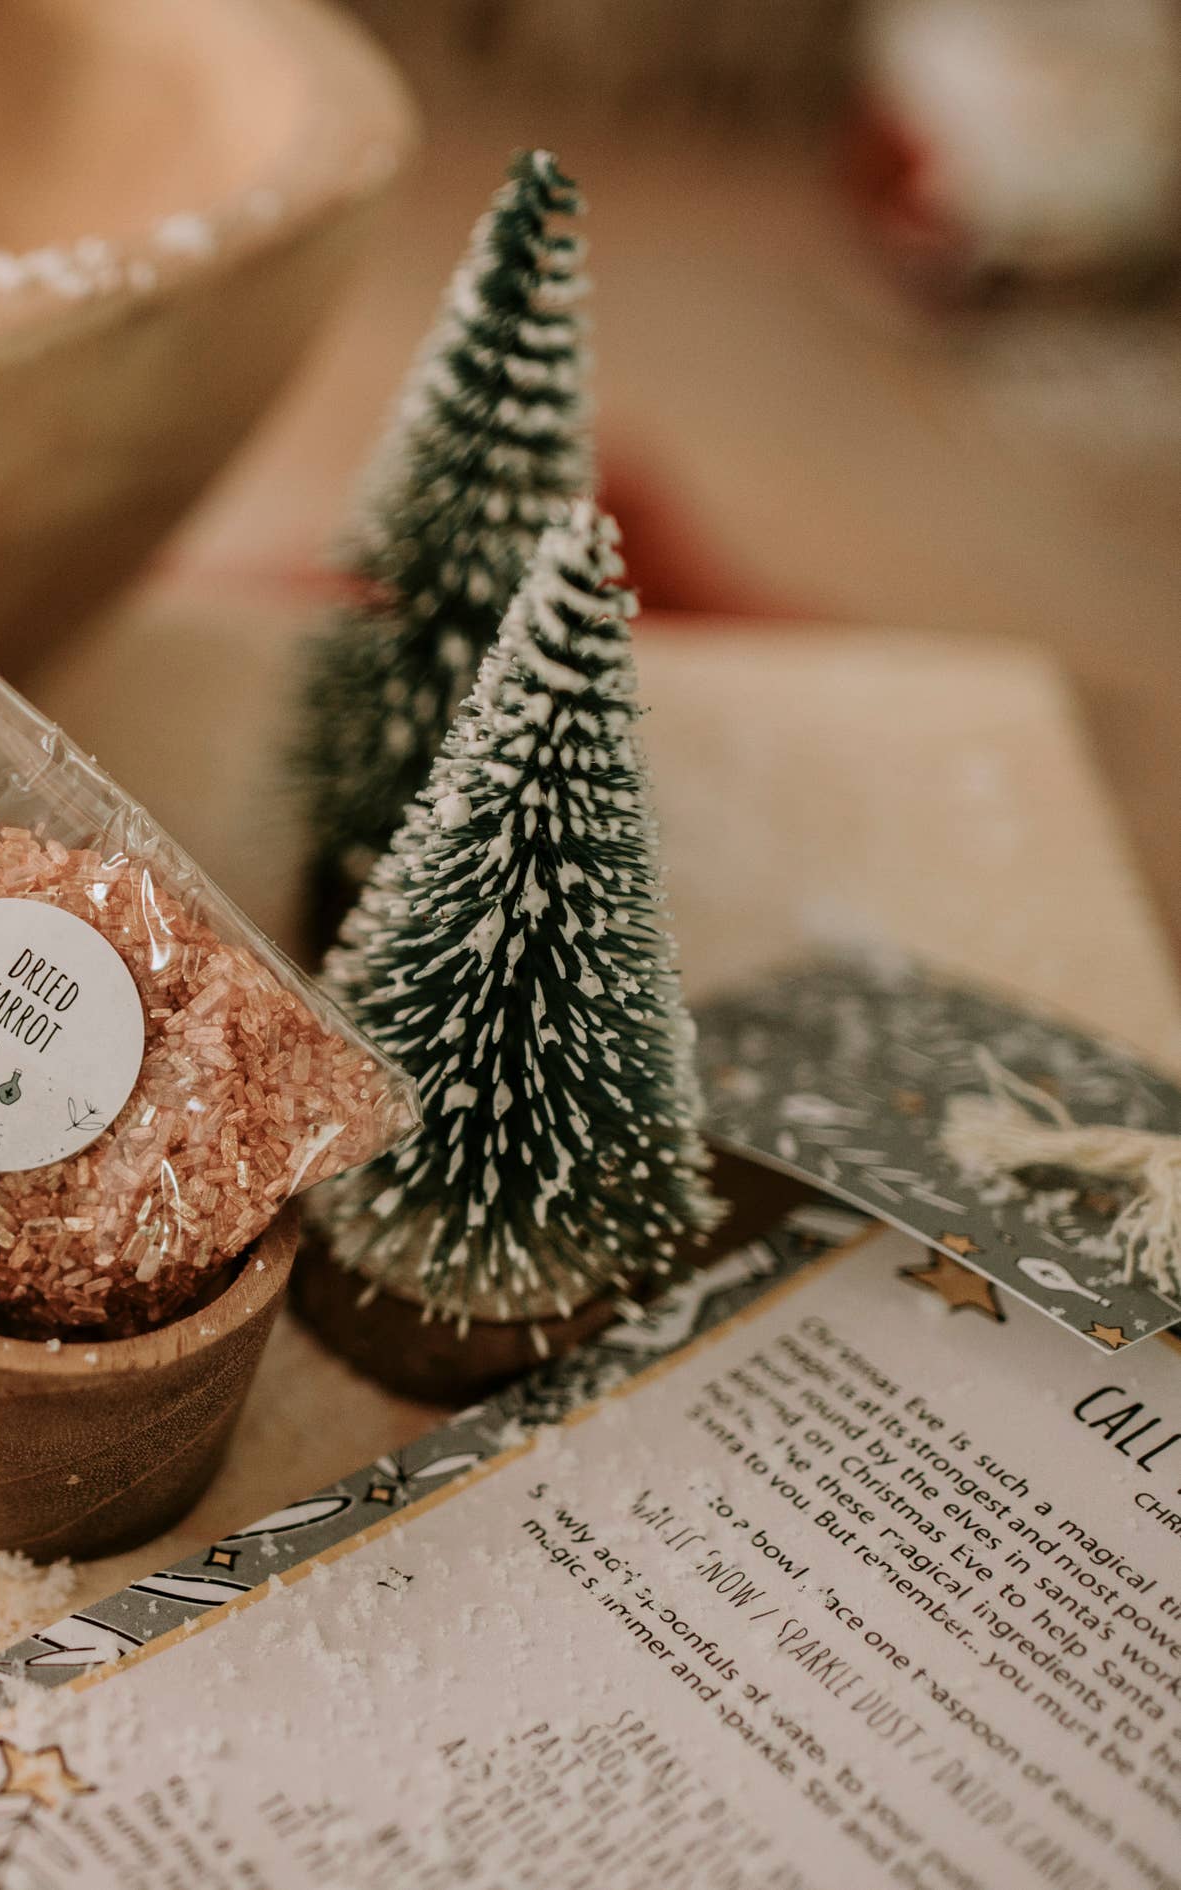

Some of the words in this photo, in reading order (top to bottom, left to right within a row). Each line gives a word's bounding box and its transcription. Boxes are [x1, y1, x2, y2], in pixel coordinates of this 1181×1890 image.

[8, 948, 79, 1012] DRIED
[798, 1316, 901, 1397] Chrstmas
[904, 1396, 945, 1432] Eve
[949, 1431, 971, 1452] is
[973, 1453, 1029, 1498] such
[1034, 1501, 1053, 1516] a
[1058, 1519, 1158, 1594] magical
[799, 1389, 868, 1441] round
[866, 1438, 899, 1467] by
[899, 1467, 940, 1500] the
[943, 1502, 1003, 1550] elves
[1004, 1549, 1031, 1575] in
[837, 1382, 857, 1399] is
[855, 1400, 883, 1418] at
[879, 1414, 908, 1440] its
[905, 1436, 1012, 1520] strongest
[1008, 1518, 1061, 1556] and
[1054, 1553, 1120, 1605] most
[1073, 1386, 1181, 1473] CALL
[528, 1483, 595, 1544] Swly
[835, 1766, 865, 1795] to
[743, 1452, 769, 1476] to
[813, 1510, 857, 1546] But
[853, 1544, 979, 1655] remember...
[979, 1652, 1035, 1696] you
[1099, 1743, 1135, 1776] be
[804, 1429, 835, 1455] on
[839, 1455, 946, 1544] Christmas
[950, 1544, 993, 1582] Eve
[999, 1583, 1026, 1609] to
[1032, 1609, 1088, 1659] help
[1093, 1659, 1165, 1720] Santa
[816, 1473, 876, 1525] these
[972, 1600, 1106, 1713] ingredients
[1113, 1714, 1143, 1741] to
[671, 1662, 722, 1702] and
[777, 1618, 864, 1698] SPARKLE
[850, 1690, 926, 1748] DUST
[819, 1587, 864, 1631] ace
[864, 1631, 910, 1669] one
[1022, 1763, 1058, 1787] of
